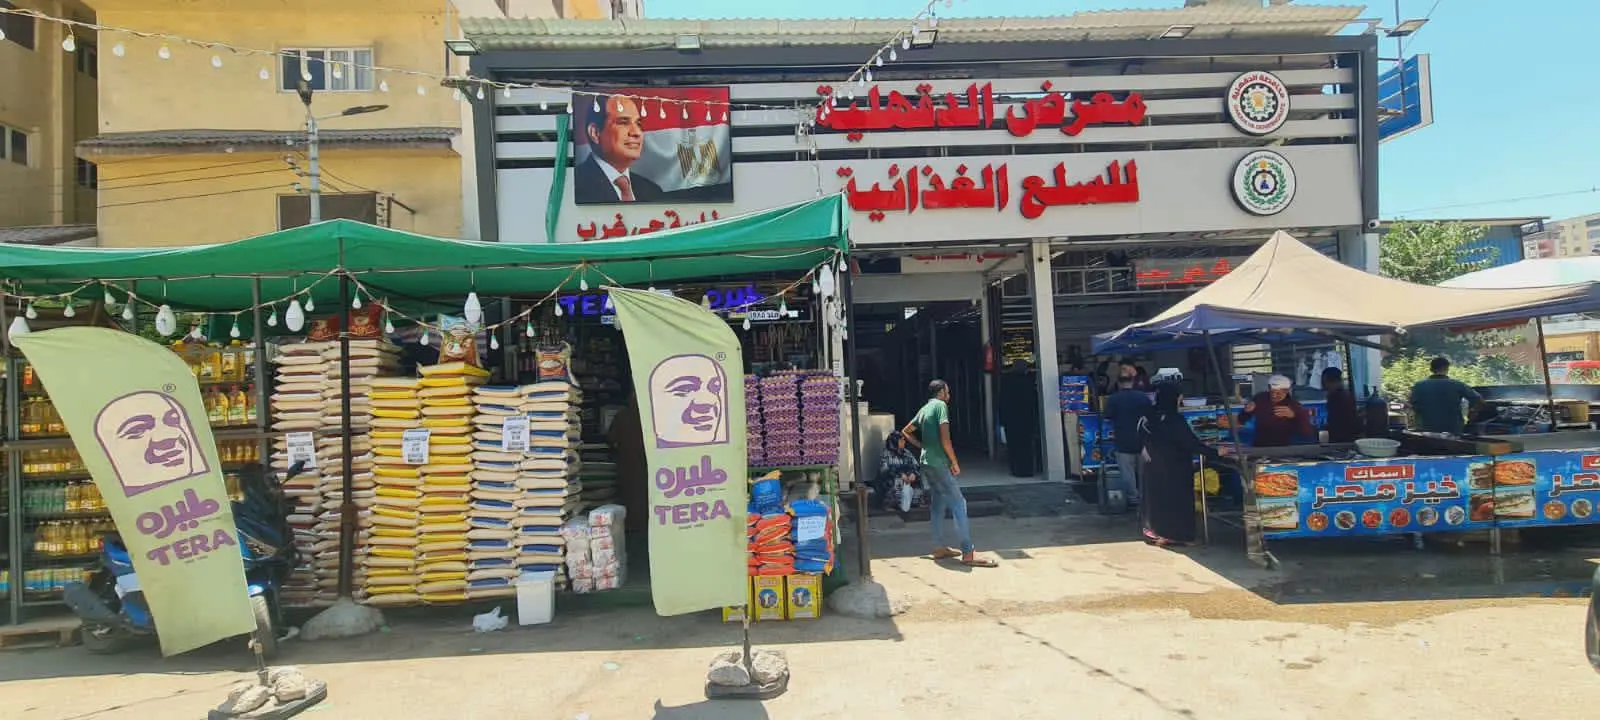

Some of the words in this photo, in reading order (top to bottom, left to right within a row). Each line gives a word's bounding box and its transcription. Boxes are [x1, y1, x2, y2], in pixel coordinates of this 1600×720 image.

[815, 81, 994, 143] الدقهلية
[1006, 80, 1148, 138] معرض
[836, 161, 1009, 223] الغذائية
[1019, 158, 1141, 220] للسلع
[577, 212, 628, 242] غرب
[655, 454, 728, 499] طيره
[1312, 482, 1397, 509] مصر
[1401, 475, 1460, 505] خير
[1548, 472, 1600, 498] صر
[136, 488, 220, 540] طيره
[653, 499, 732, 527] TERA
[146, 528, 236, 566] TERA
